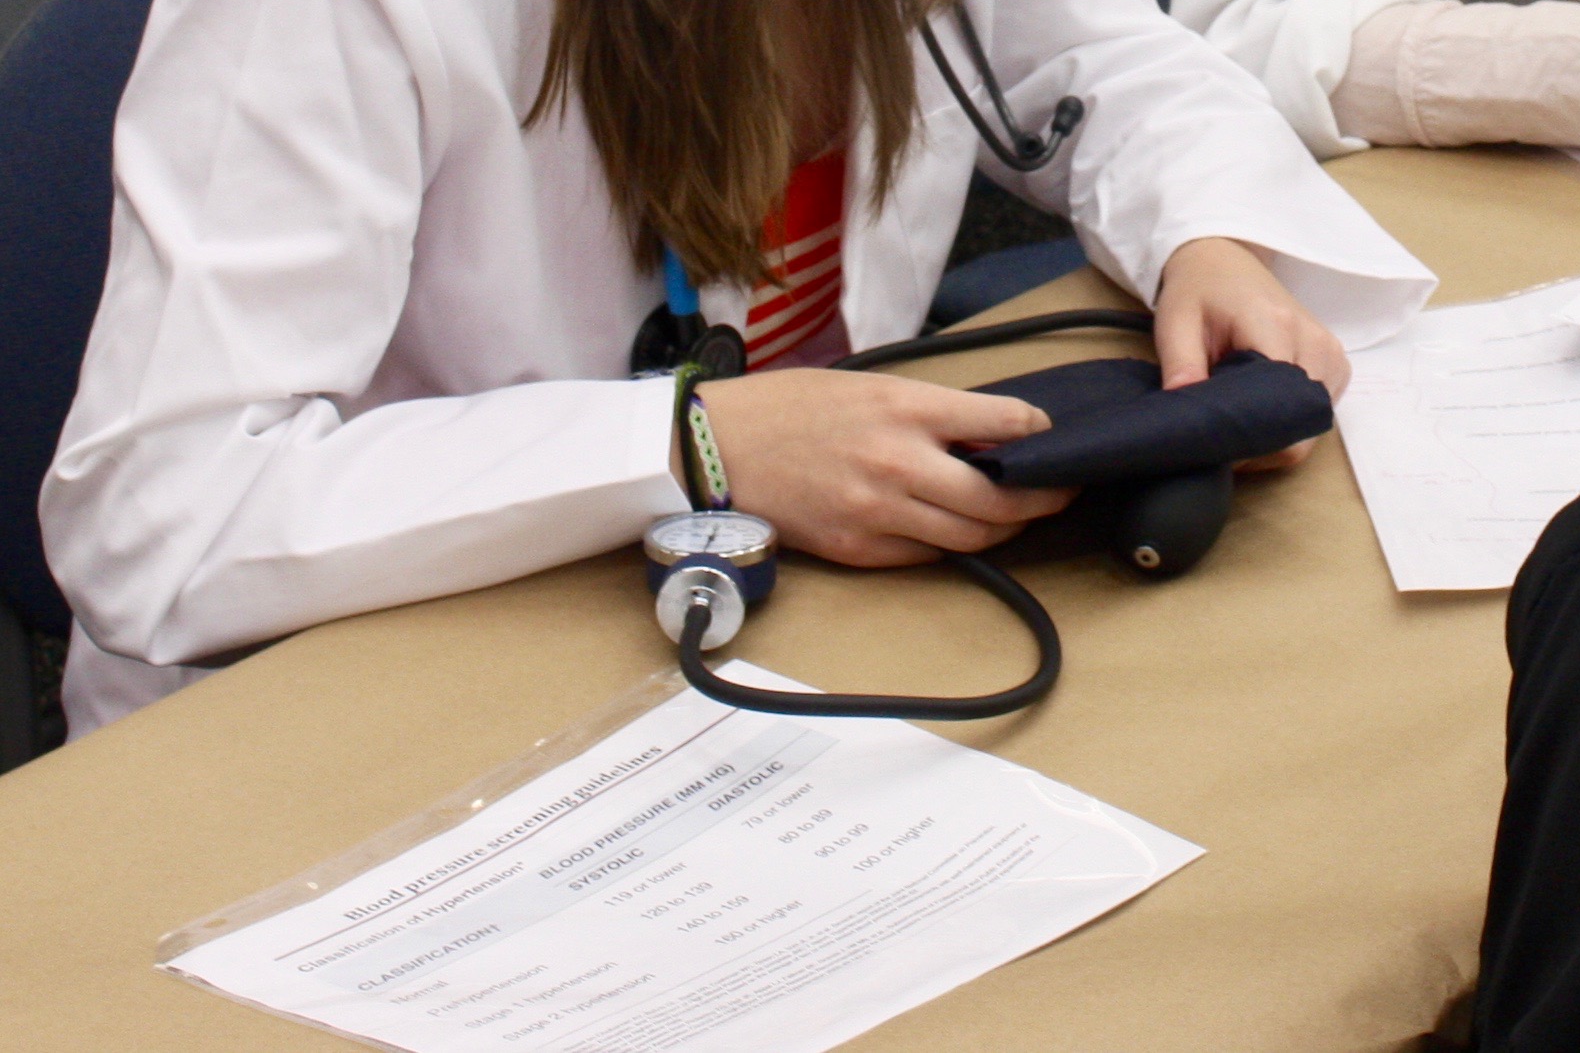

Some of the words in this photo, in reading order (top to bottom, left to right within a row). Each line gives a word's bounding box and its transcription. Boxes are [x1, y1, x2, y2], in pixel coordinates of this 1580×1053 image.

[708, 760, 785, 812] DIASTOLIC
[740, 815, 764, 830] 79
[762, 805, 779, 818] or
[774, 782, 814, 808] lower
[343, 888, 403, 921] Blood
[405, 844, 488, 896] pressure
[487, 793, 579, 850] screening
[573, 745, 664, 800] guidelines
[538, 846, 595, 880] BLOOD
[594, 797, 677, 850] PRESSURE
[675, 779, 707, 803] (MM
[705, 762, 736, 784] HG)
[777, 830, 801, 845] 80
[797, 821, 815, 833] to
[811, 808, 834, 823] 89
[814, 844, 837, 859] 90
[833, 835, 852, 848] to
[847, 822, 870, 838] 99
[852, 855, 883, 872] 100
[880, 844, 897, 857] or
[893, 814, 938, 847] higher
[568, 847, 645, 892] SYSTOLIC
[604, 890, 633, 907] 119
[633, 881, 649, 894] or
[647, 861, 688, 885] lower
[640, 904, 670, 921] 120
[668, 896, 686, 907] to
[683, 881, 714, 898] 139
[676, 917, 707, 934] 140
[704, 910, 723, 921] to
[714, 929, 744, 946] 160
[743, 922, 760, 934] or
[756, 899, 804, 926] higher
[297, 921, 406, 974] Classification
[406, 912, 424, 927] of
[390, 979, 450, 1006] Normal
[464, 1005, 515, 1030] Stage
[523, 961, 619, 1006] hypertension
[560, 971, 657, 1016] hypertension
